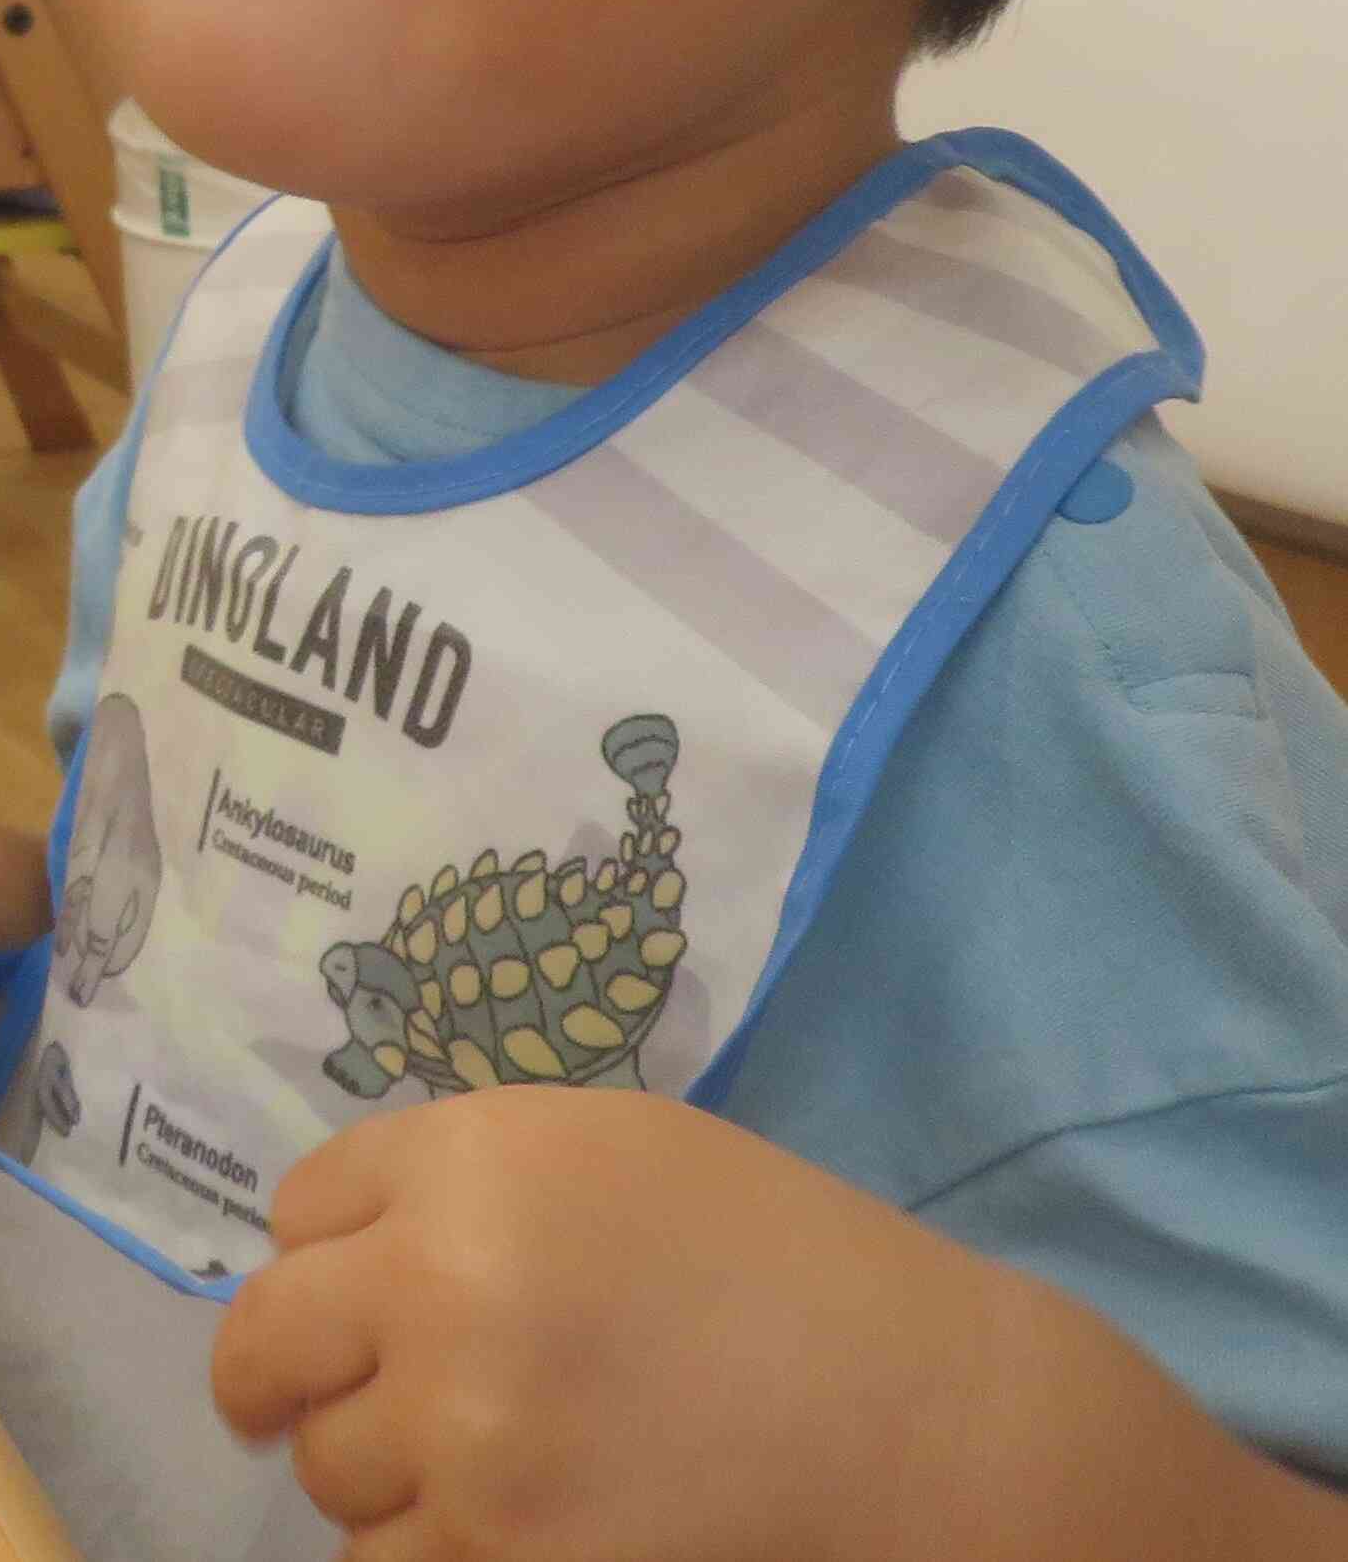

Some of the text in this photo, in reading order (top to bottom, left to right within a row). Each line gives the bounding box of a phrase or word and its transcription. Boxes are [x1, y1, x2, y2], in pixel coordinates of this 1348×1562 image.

[148, 515, 472, 749] DINOLAND
[217, 788, 356, 875] Ankylosaurus
[296, 872, 351, 910] period
[144, 1103, 259, 1193] Pteranodon
